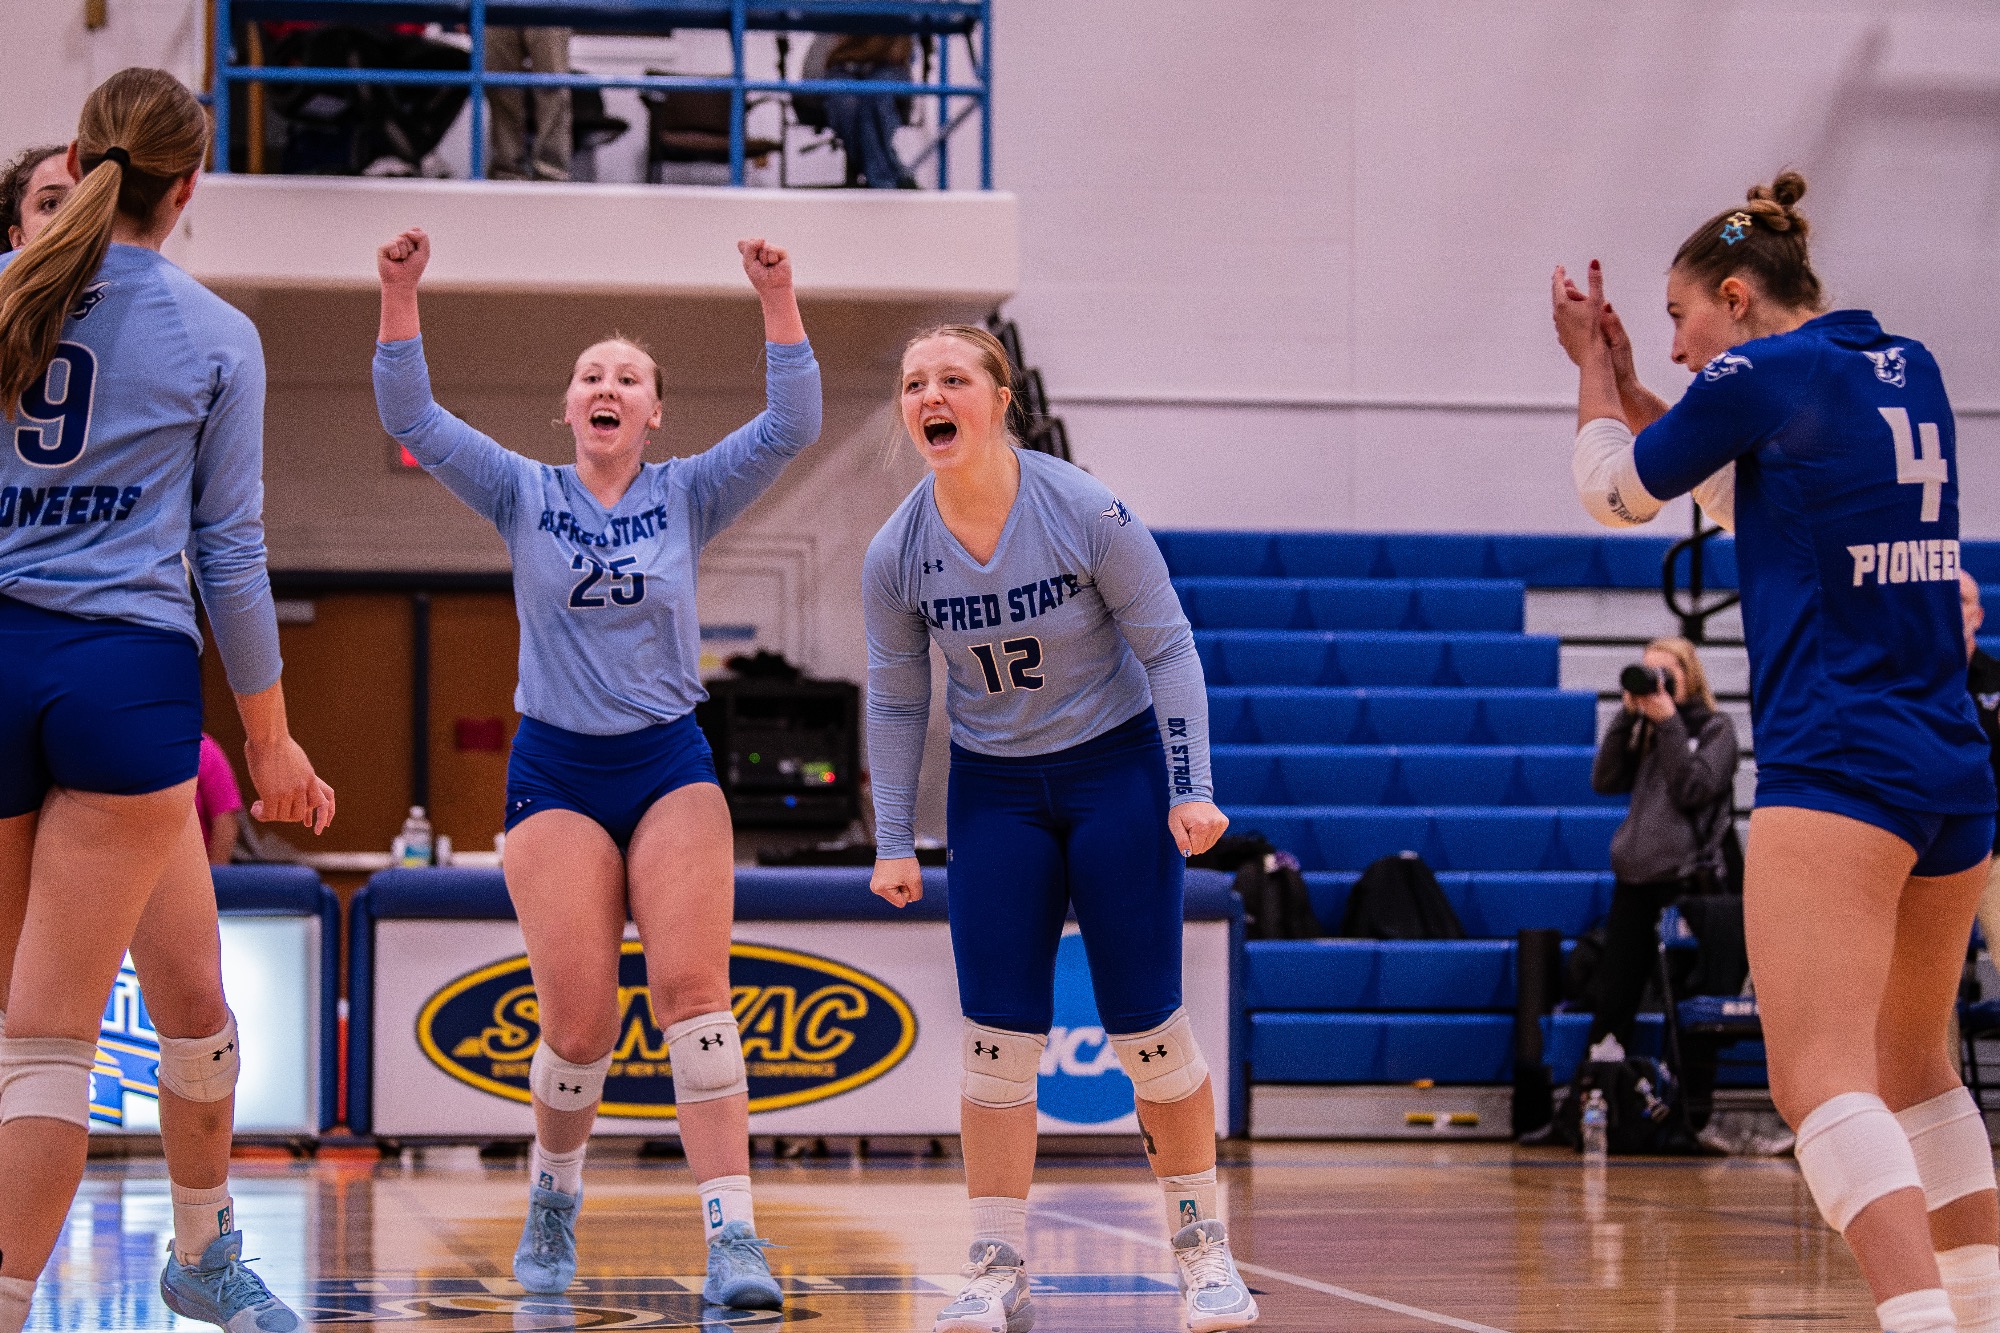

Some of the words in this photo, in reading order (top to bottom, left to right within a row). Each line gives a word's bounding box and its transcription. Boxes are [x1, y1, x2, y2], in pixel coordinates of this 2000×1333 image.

[14, 340, 98, 469] 9
[1877, 407, 1949, 523] 4
[0, 485, 142, 527] ONEERS
[609, 504, 668, 547] STATE
[568, 553, 647, 609] 25
[917, 593, 1002, 632] LFRED
[1007, 573, 1082, 623] STATE
[967, 635, 1045, 695] 12
[1167, 717, 1187, 739] OX
